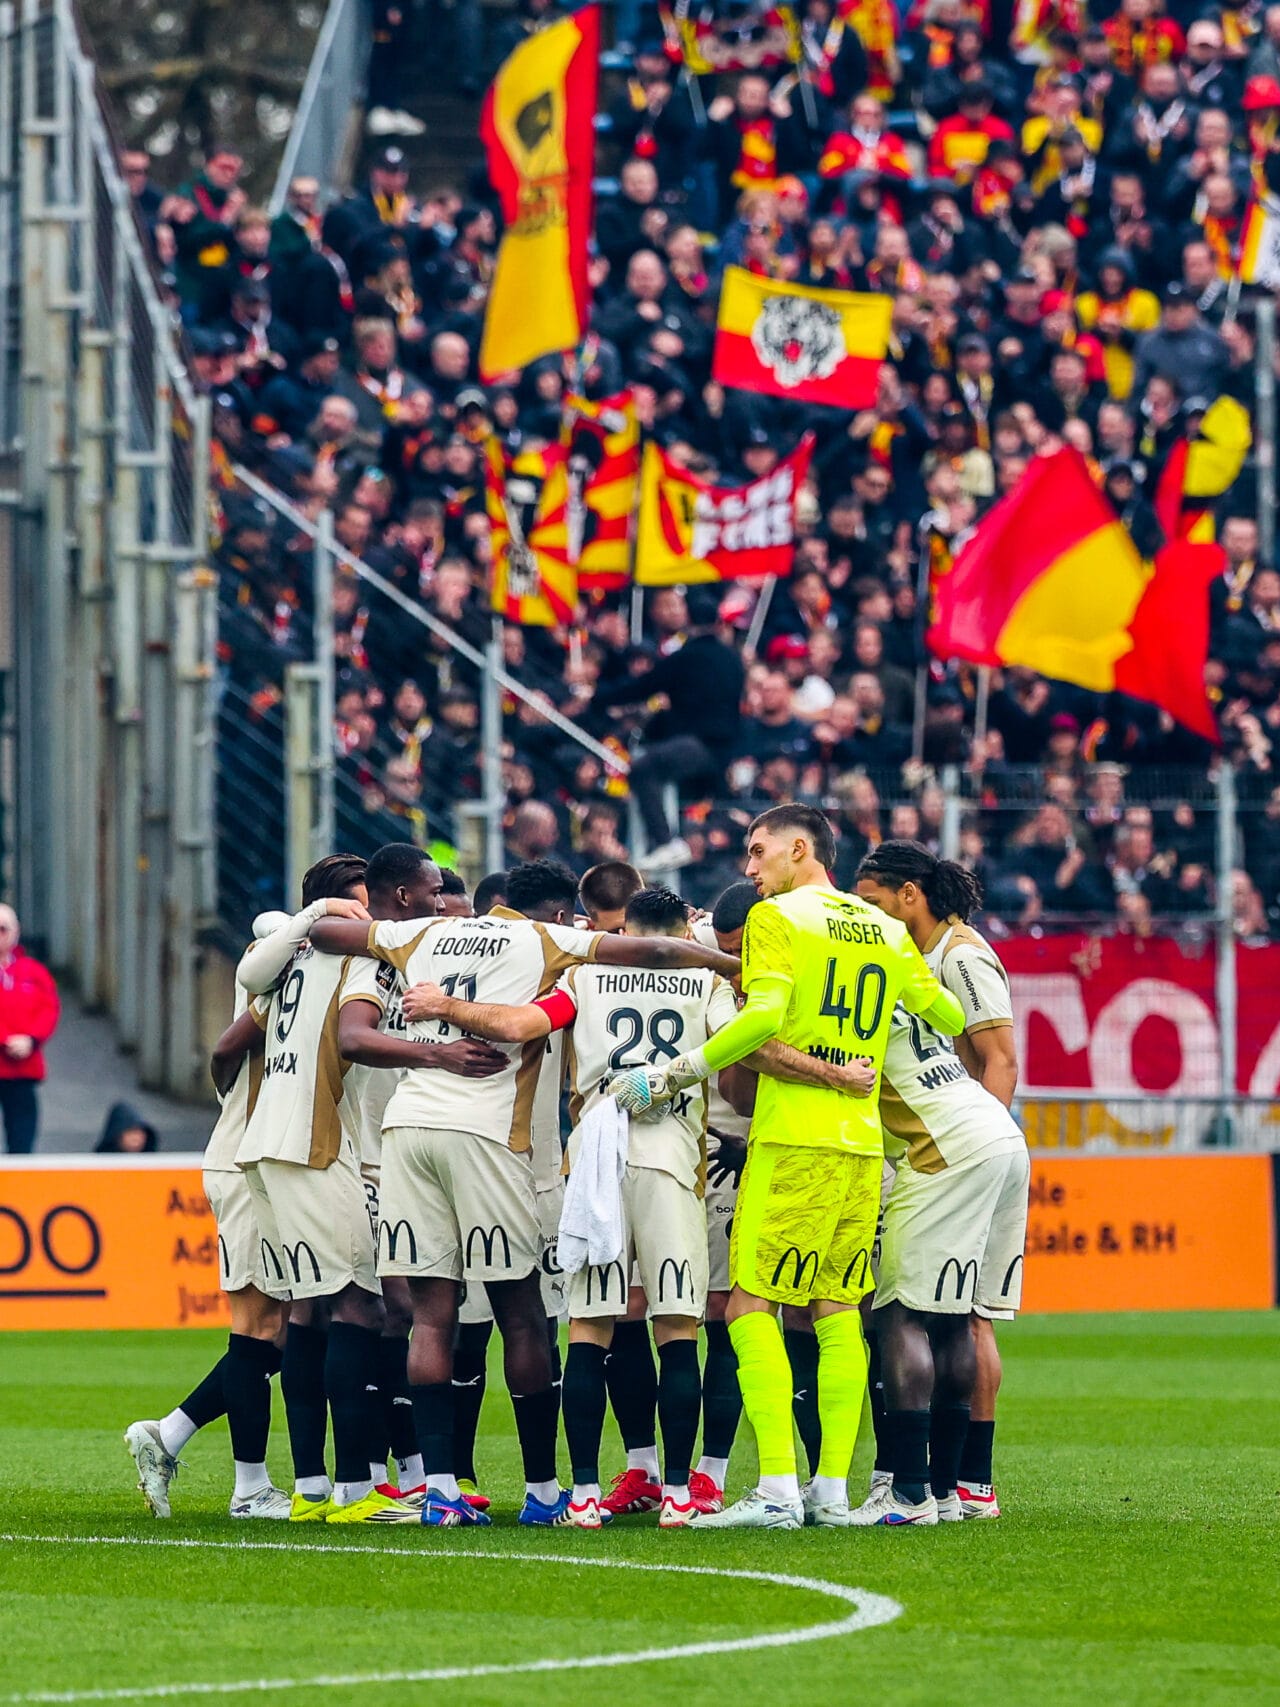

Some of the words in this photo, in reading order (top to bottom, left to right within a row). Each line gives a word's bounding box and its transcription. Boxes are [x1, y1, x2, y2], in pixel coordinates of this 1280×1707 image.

[826, 918, 886, 946] RISSER
[275, 968, 305, 1044] 9
[596, 973, 704, 998] THOMASSON
[819, 956, 887, 1041] 40
[956, 960, 982, 1012] AUSHOPPING
[606, 1007, 685, 1071] 28
[173, 1235, 218, 1264] Ad
[1026, 1223, 1087, 1255] iale
[1098, 1222, 1121, 1255] &
[1132, 1221, 1176, 1255] RH
